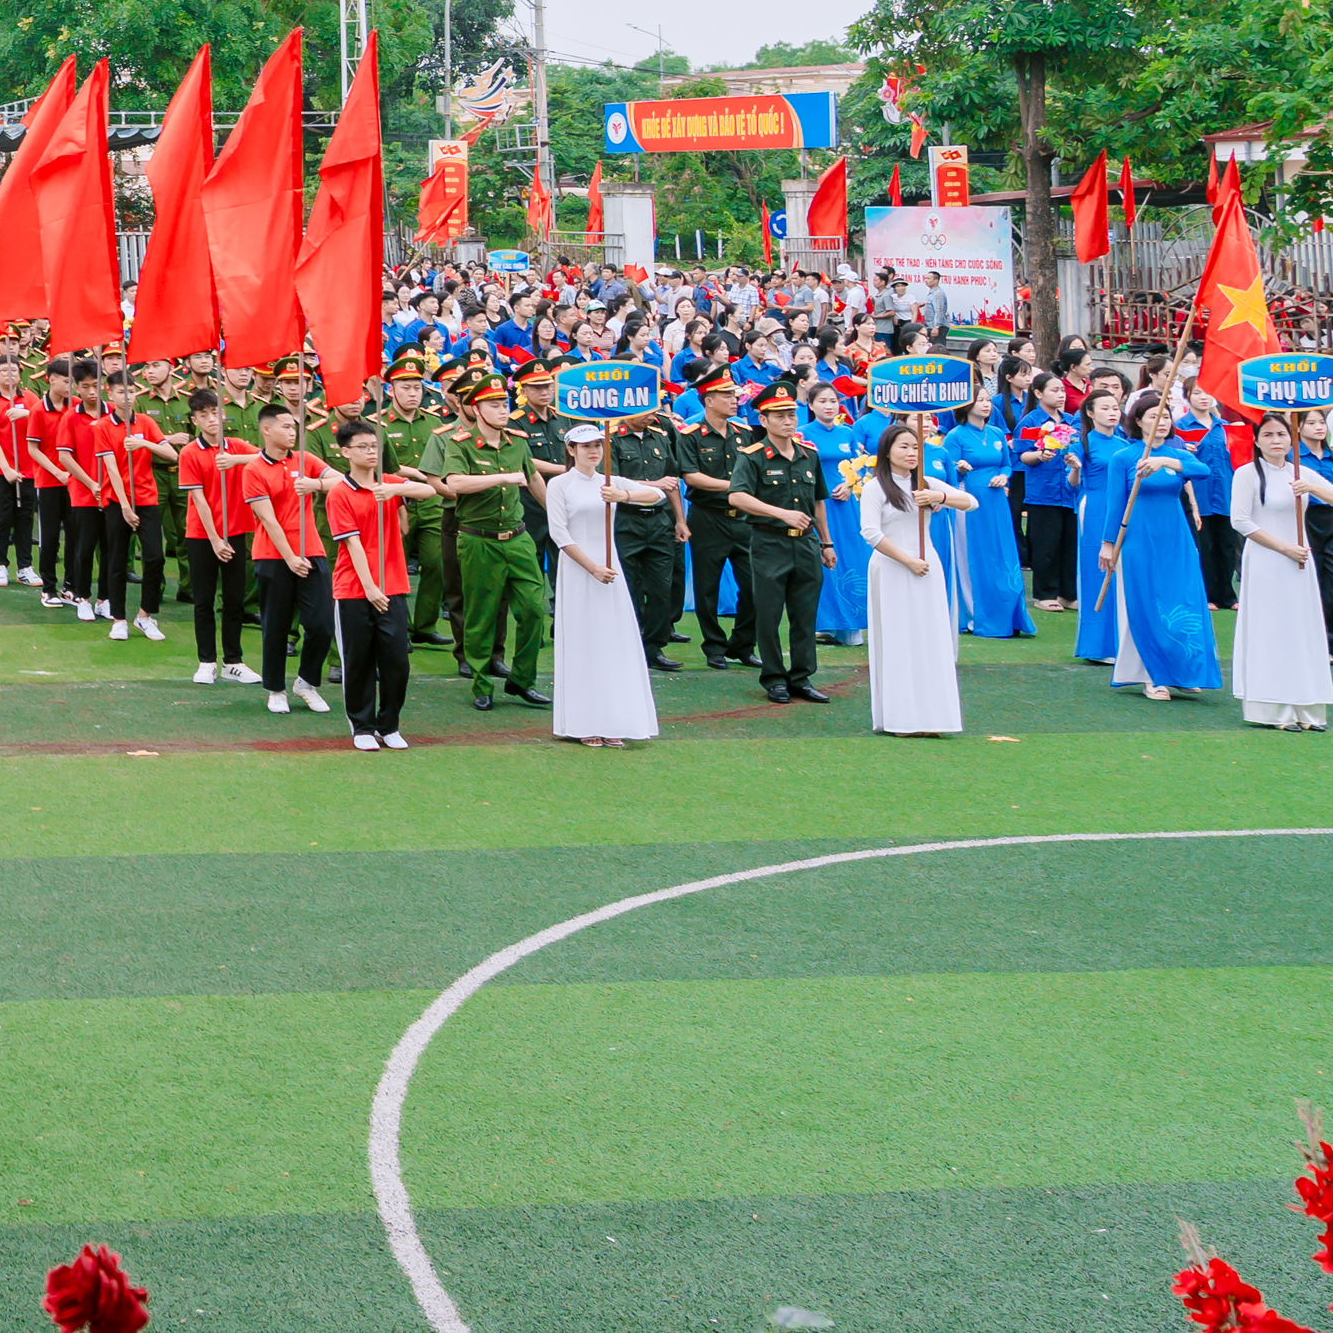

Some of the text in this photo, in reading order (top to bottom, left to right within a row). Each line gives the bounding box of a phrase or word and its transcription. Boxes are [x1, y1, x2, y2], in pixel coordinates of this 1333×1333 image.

[641, 105, 784, 142] KHỎE ĐỂ XÂY DỰNG VÀ BẢO VỆ TỔ QUỐC !
[906, 257, 920, 267] THAO
[954, 259, 966, 269] CHO
[585, 366, 630, 382] KHỐI
[899, 360, 943, 375] KHỐI
[1269, 358, 1317, 373] KHỐI
[566, 384, 650, 410] CÔNG AN
[873, 377, 968, 408] CỰU CHIẾN BINH
[1256, 376, 1333, 404] PHỤ NỮ
